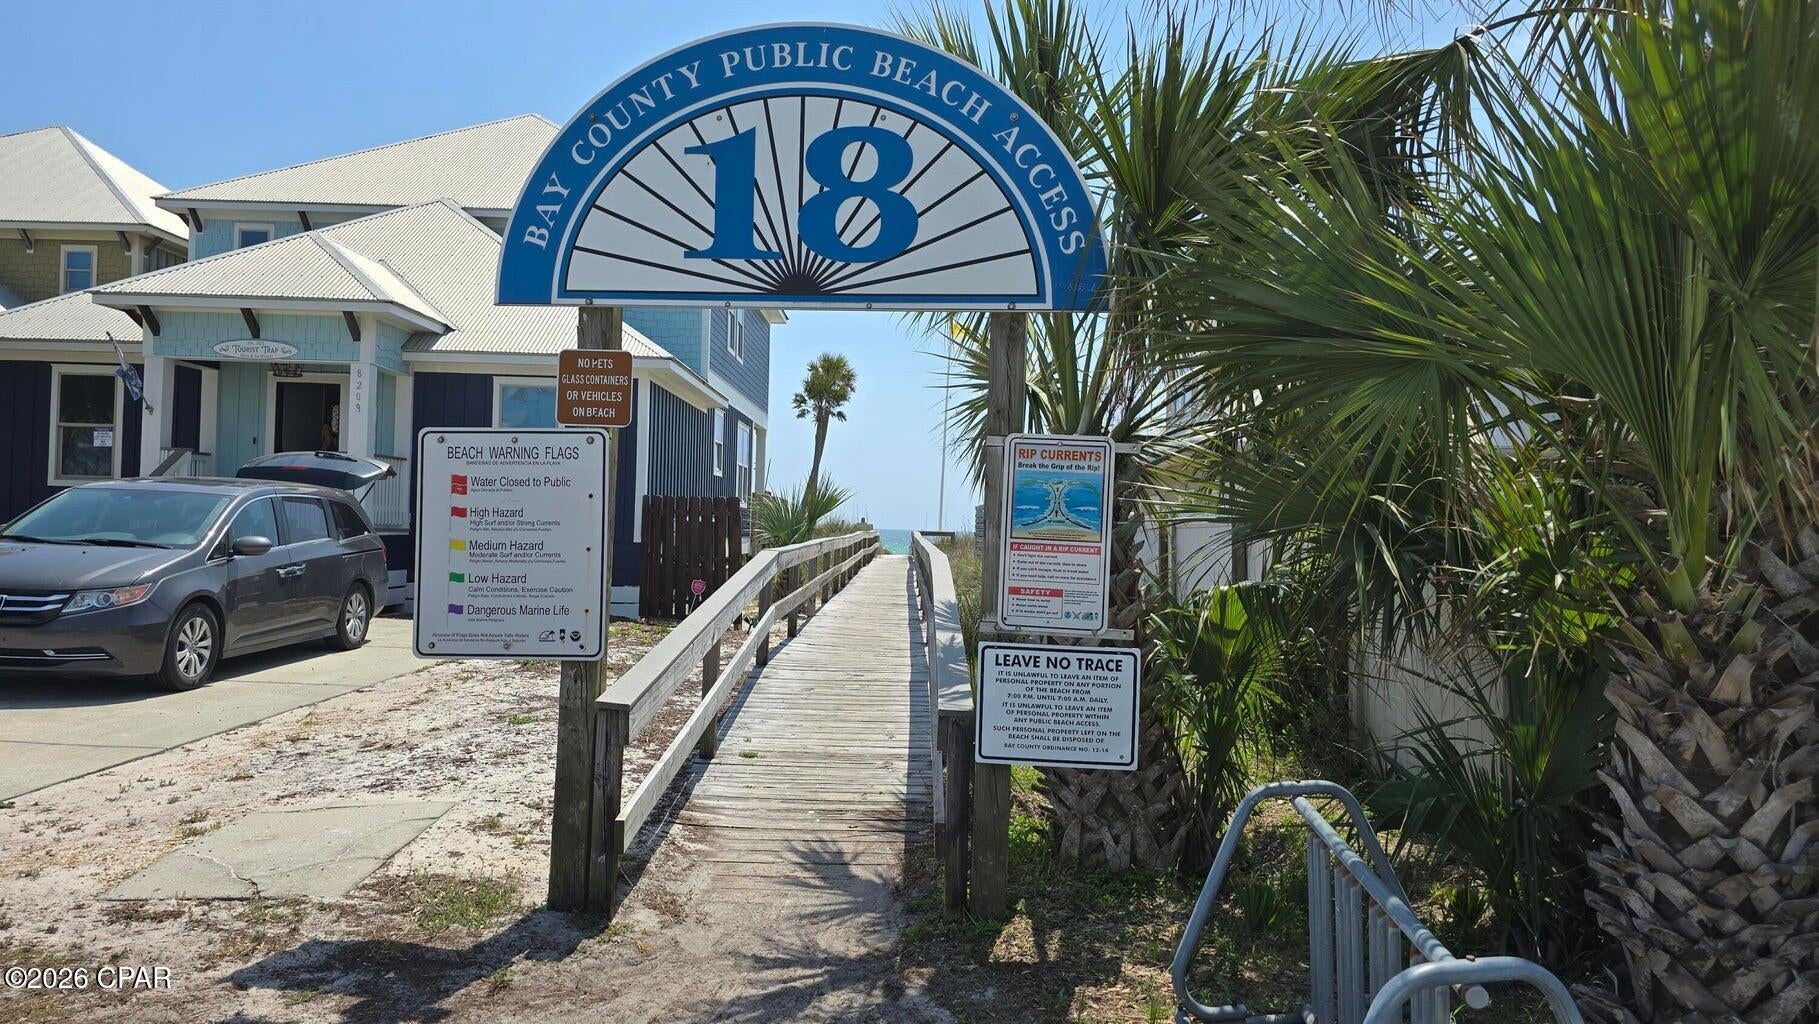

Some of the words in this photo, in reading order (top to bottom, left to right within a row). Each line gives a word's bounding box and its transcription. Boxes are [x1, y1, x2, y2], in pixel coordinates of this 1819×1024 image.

[523, 171, 571, 250] BAY
[571, 60, 702, 165] COUNTY
[719, 42, 853, 77] PUBLIC
[870, 50, 992, 124] BEACH
[992, 125, 1086, 254] ACCESS
[684, 126, 918, 264] 18
[578, 359, 589, 368] NO
[592, 359, 613, 368] PETS
[562, 374, 584, 384] GLASS
[586, 375, 628, 385] CONTAINERS
[567, 391, 578, 400] OR
[581, 391, 622, 401] VEHICLES
[573, 407, 584, 416] ON
[587, 408, 615, 417] BEACH
[448, 447, 483, 459] BEACH
[489, 447, 539, 459] WARNING
[545, 447, 579, 460] FLAGS
[1019, 449, 1036, 458] RIP
[1041, 450, 1101, 461] CURRENTS
[471, 477, 496, 487] Water
[500, 476, 530, 487] Closed
[533, 477, 541, 487] to
[544, 477, 571, 487] Public
[470, 507, 489, 520] High
[492, 508, 524, 517] Hazard
[469, 540, 506, 550] Medium
[510, 541, 543, 550] Hazard
[468, 573, 488, 583] Low
[492, 573, 527, 583] Hazard
[468, 605, 516, 617] Dangerous
[520, 605, 550, 615] Marine
[554, 605, 570, 615] Life
[995, 654, 1040, 667] LEAVE
[1047, 657, 1070, 669] NO
[1077, 658, 1122, 672] TRACE
